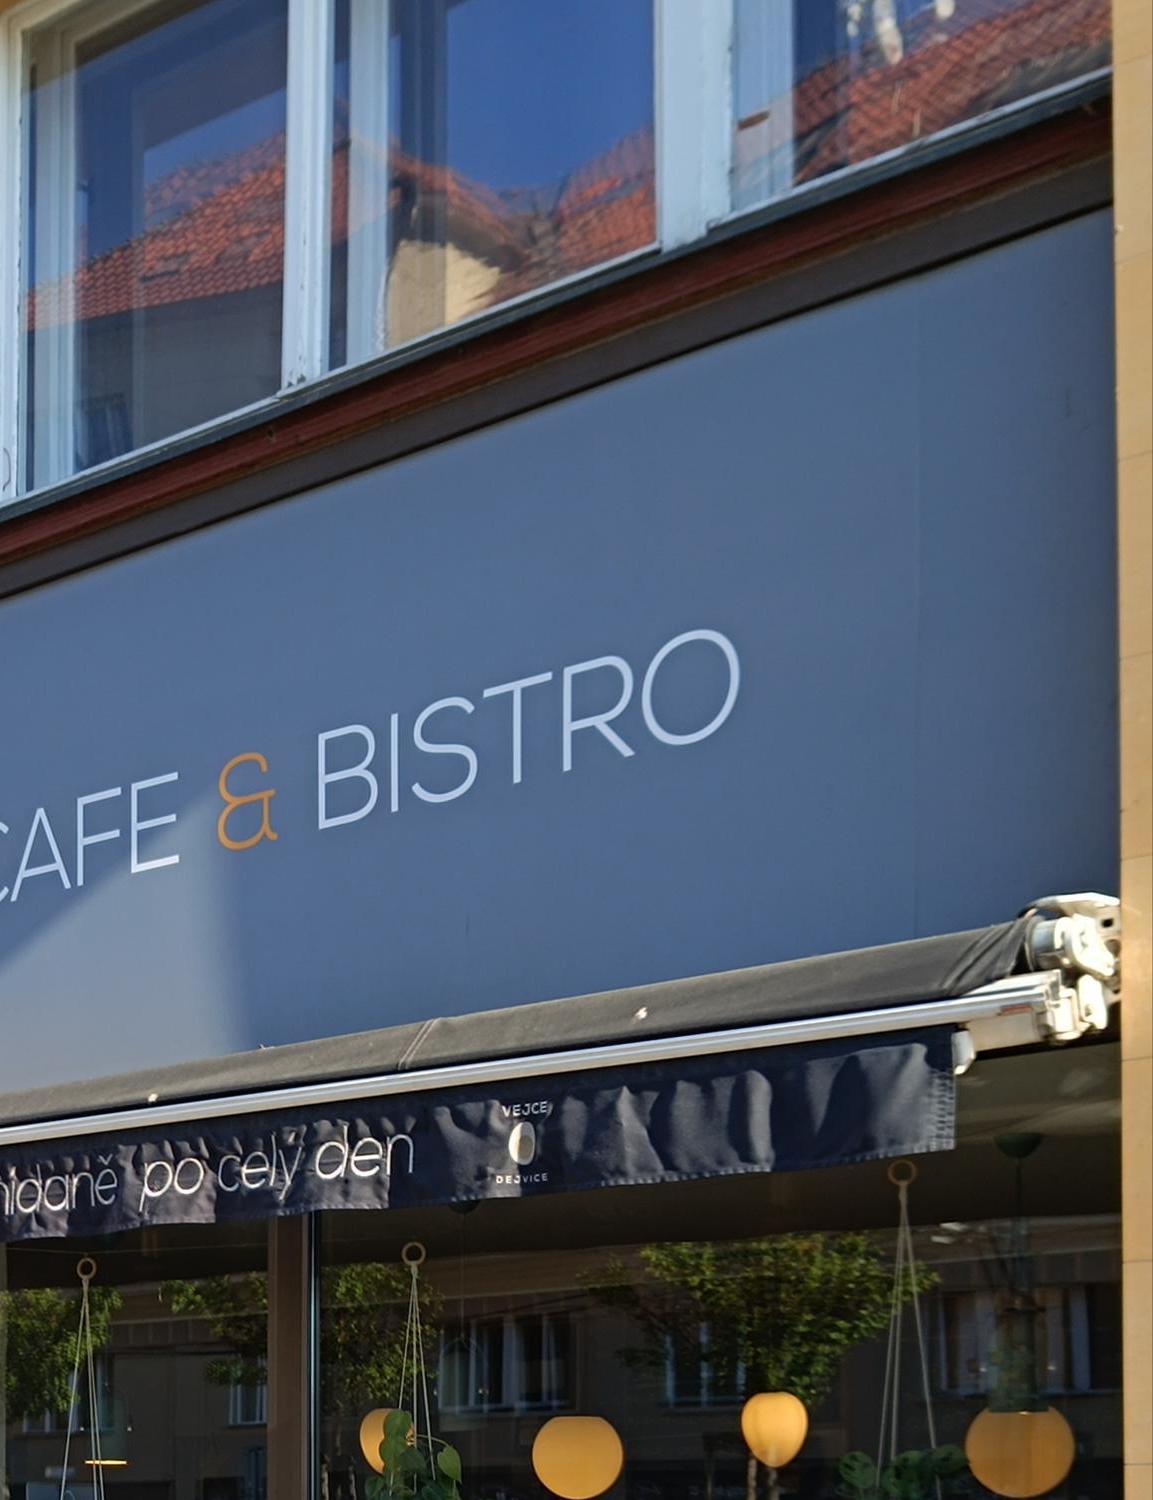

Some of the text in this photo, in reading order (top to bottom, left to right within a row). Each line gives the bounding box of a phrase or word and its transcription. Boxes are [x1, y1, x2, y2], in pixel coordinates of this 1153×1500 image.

[216, 752, 279, 851] &
[317, 628, 742, 831] BISTRO
[501, 1100, 548, 1117] VEJCE
[139, 1155, 206, 1212] po
[315, 1124, 414, 1180] den
[495, 1173, 548, 1184] DEJVICE
